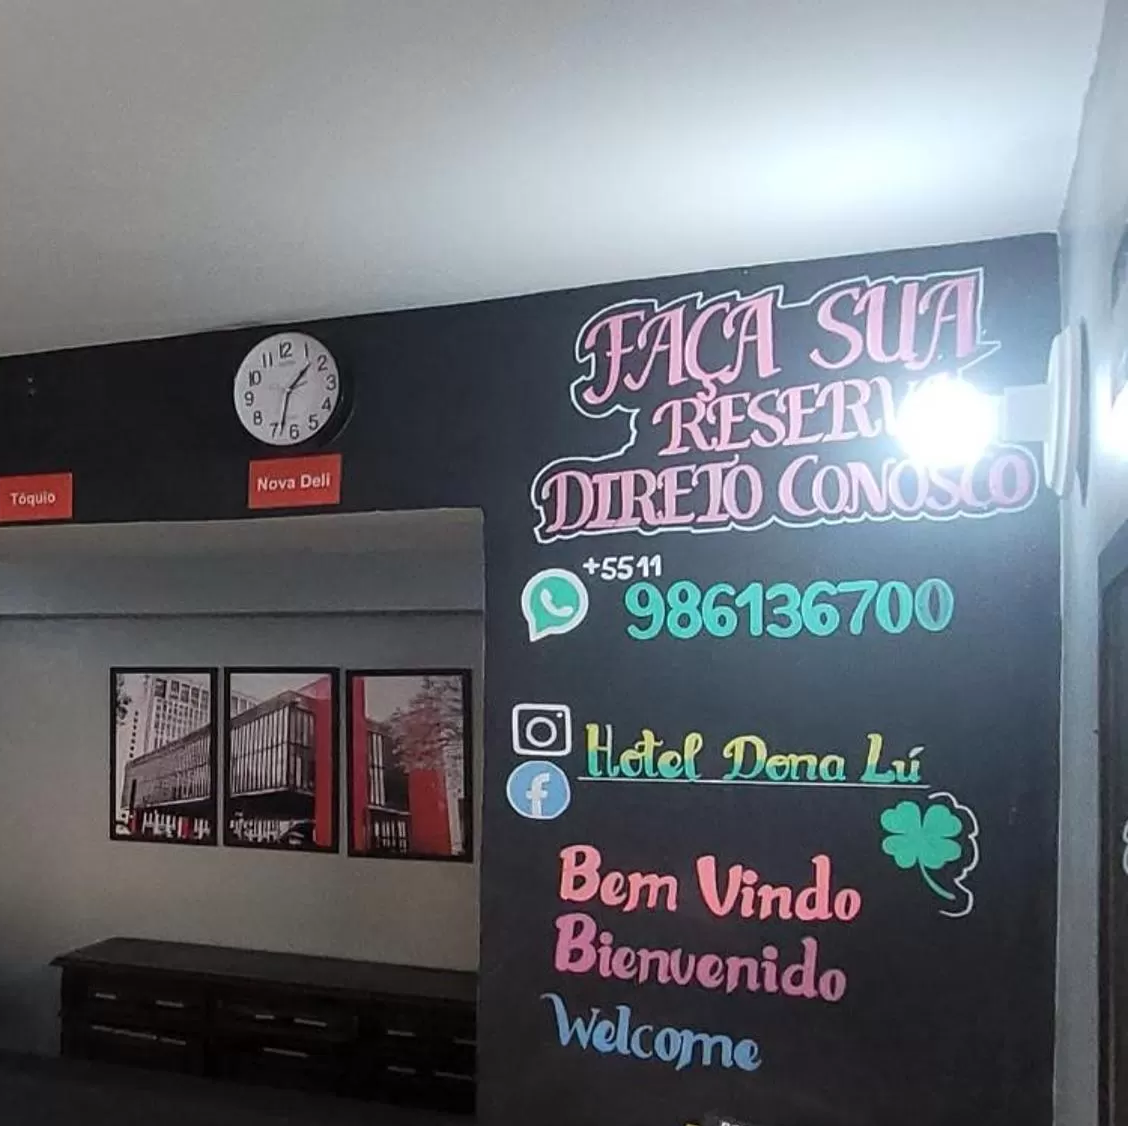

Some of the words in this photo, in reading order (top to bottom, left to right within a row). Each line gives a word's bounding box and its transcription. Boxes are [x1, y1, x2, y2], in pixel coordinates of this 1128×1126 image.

[584, 292, 781, 406] FAÇA
[809, 275, 979, 371] SUA
[279, 341, 292, 359] 12
[304, 342, 309, 358] 1
[262, 352, 273, 369] 11
[317, 355, 328, 371] 2
[249, 370, 262, 388] 10
[326, 374, 337, 391] 3
[244, 391, 254, 407] 9
[322, 397, 332, 411] 4
[253, 410, 263, 425] 8
[308, 414, 319, 431] 5
[653, 376, 938, 457] RESERV
[270, 423, 279, 438] 7
[289, 424, 300, 440] 6
[257, 477, 295, 492] Nova
[300, 472, 331, 488] Deli
[10, 490, 56, 508] Tóquio
[541, 454, 764, 533] DIRETO
[778, 454, 1032, 517] CONOSCO
[582, 554, 663, 581] +5511
[624, 577, 956, 640] 986136700
[585, 723, 703, 782] Hotel
[721, 735, 847, 782] Dona
[860, 733, 926, 784] Lú
[558, 845, 678, 912] Bem
[696, 854, 862, 922] Vindo
[554, 912, 847, 1003] Bienvenido
[541, 993, 763, 1071] Welcome
